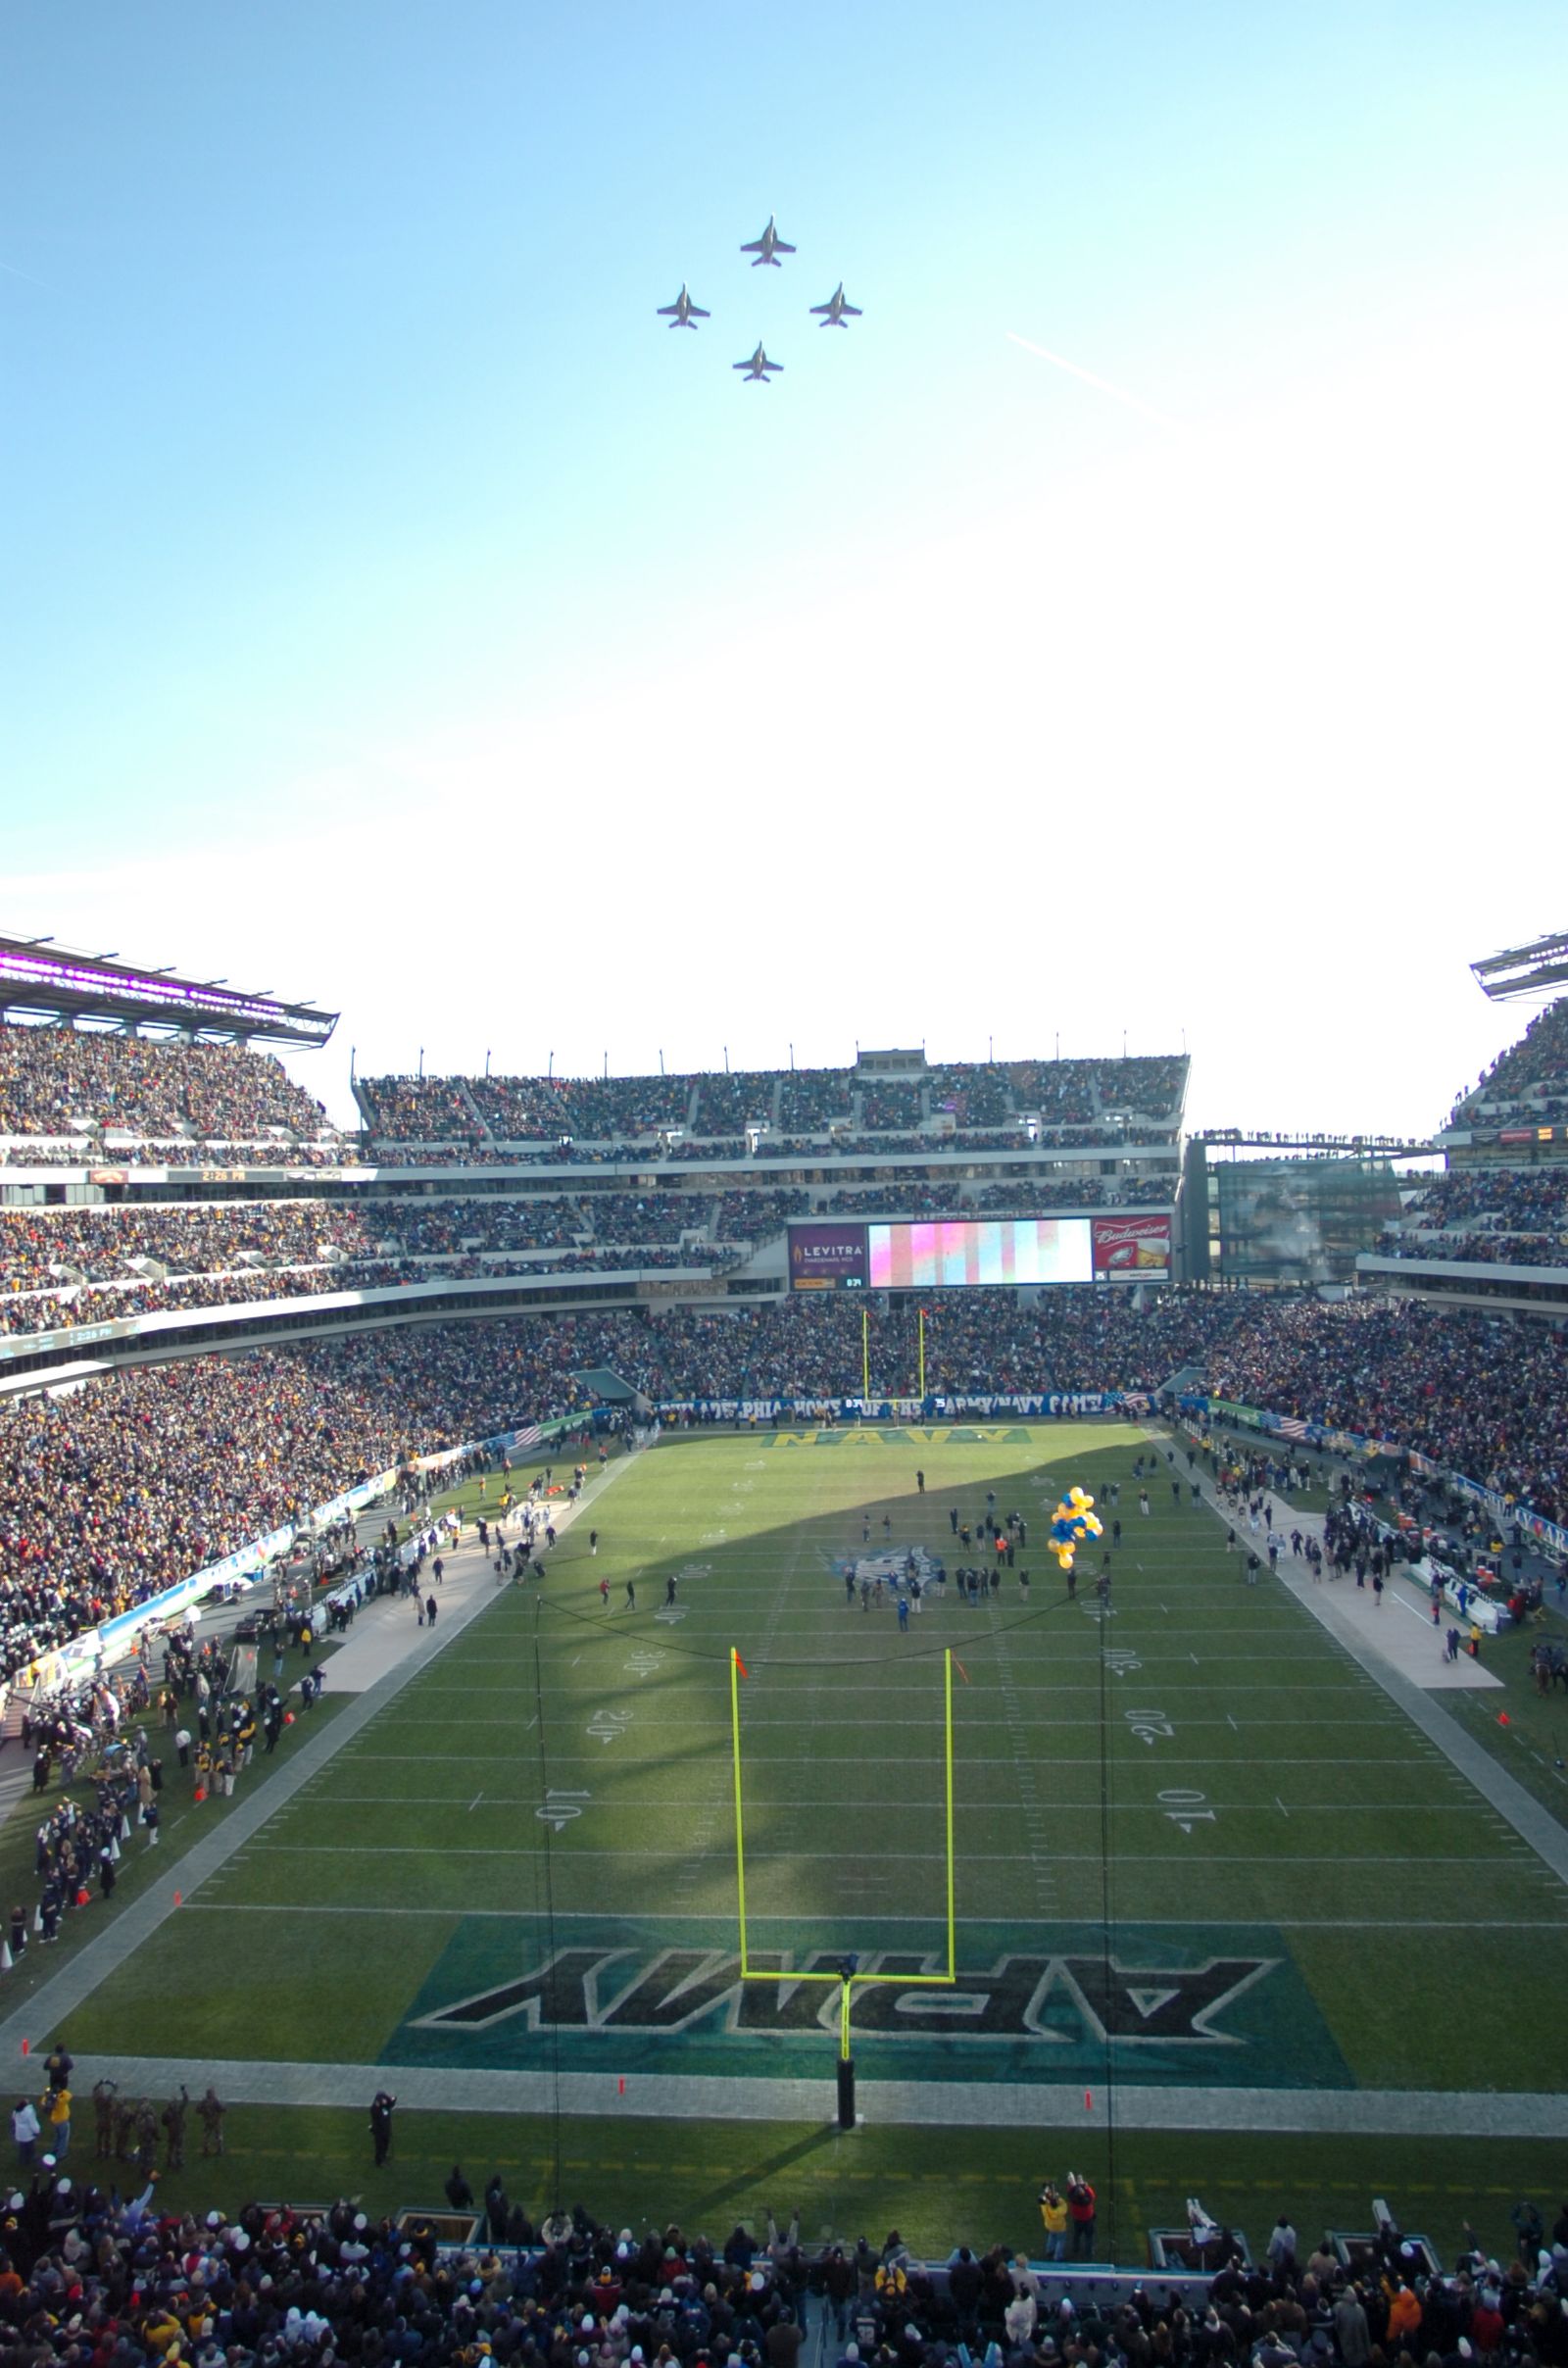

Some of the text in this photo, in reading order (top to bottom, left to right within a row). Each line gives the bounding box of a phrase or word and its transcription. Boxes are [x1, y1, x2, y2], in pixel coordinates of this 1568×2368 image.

[1096, 1224, 1168, 1244] Budweiser
[805, 1246, 862, 1257] LEVITRA
[772, 1428, 1011, 1447] NAVY
[1101, 1649, 1143, 1670] 30
[586, 1709, 634, 1736] 20
[1124, 1709, 1175, 1737] 20
[535, 1788, 591, 1820] 10
[1156, 1789, 1216, 1821] 10
[404, 1947, 1286, 2047] ARMY
